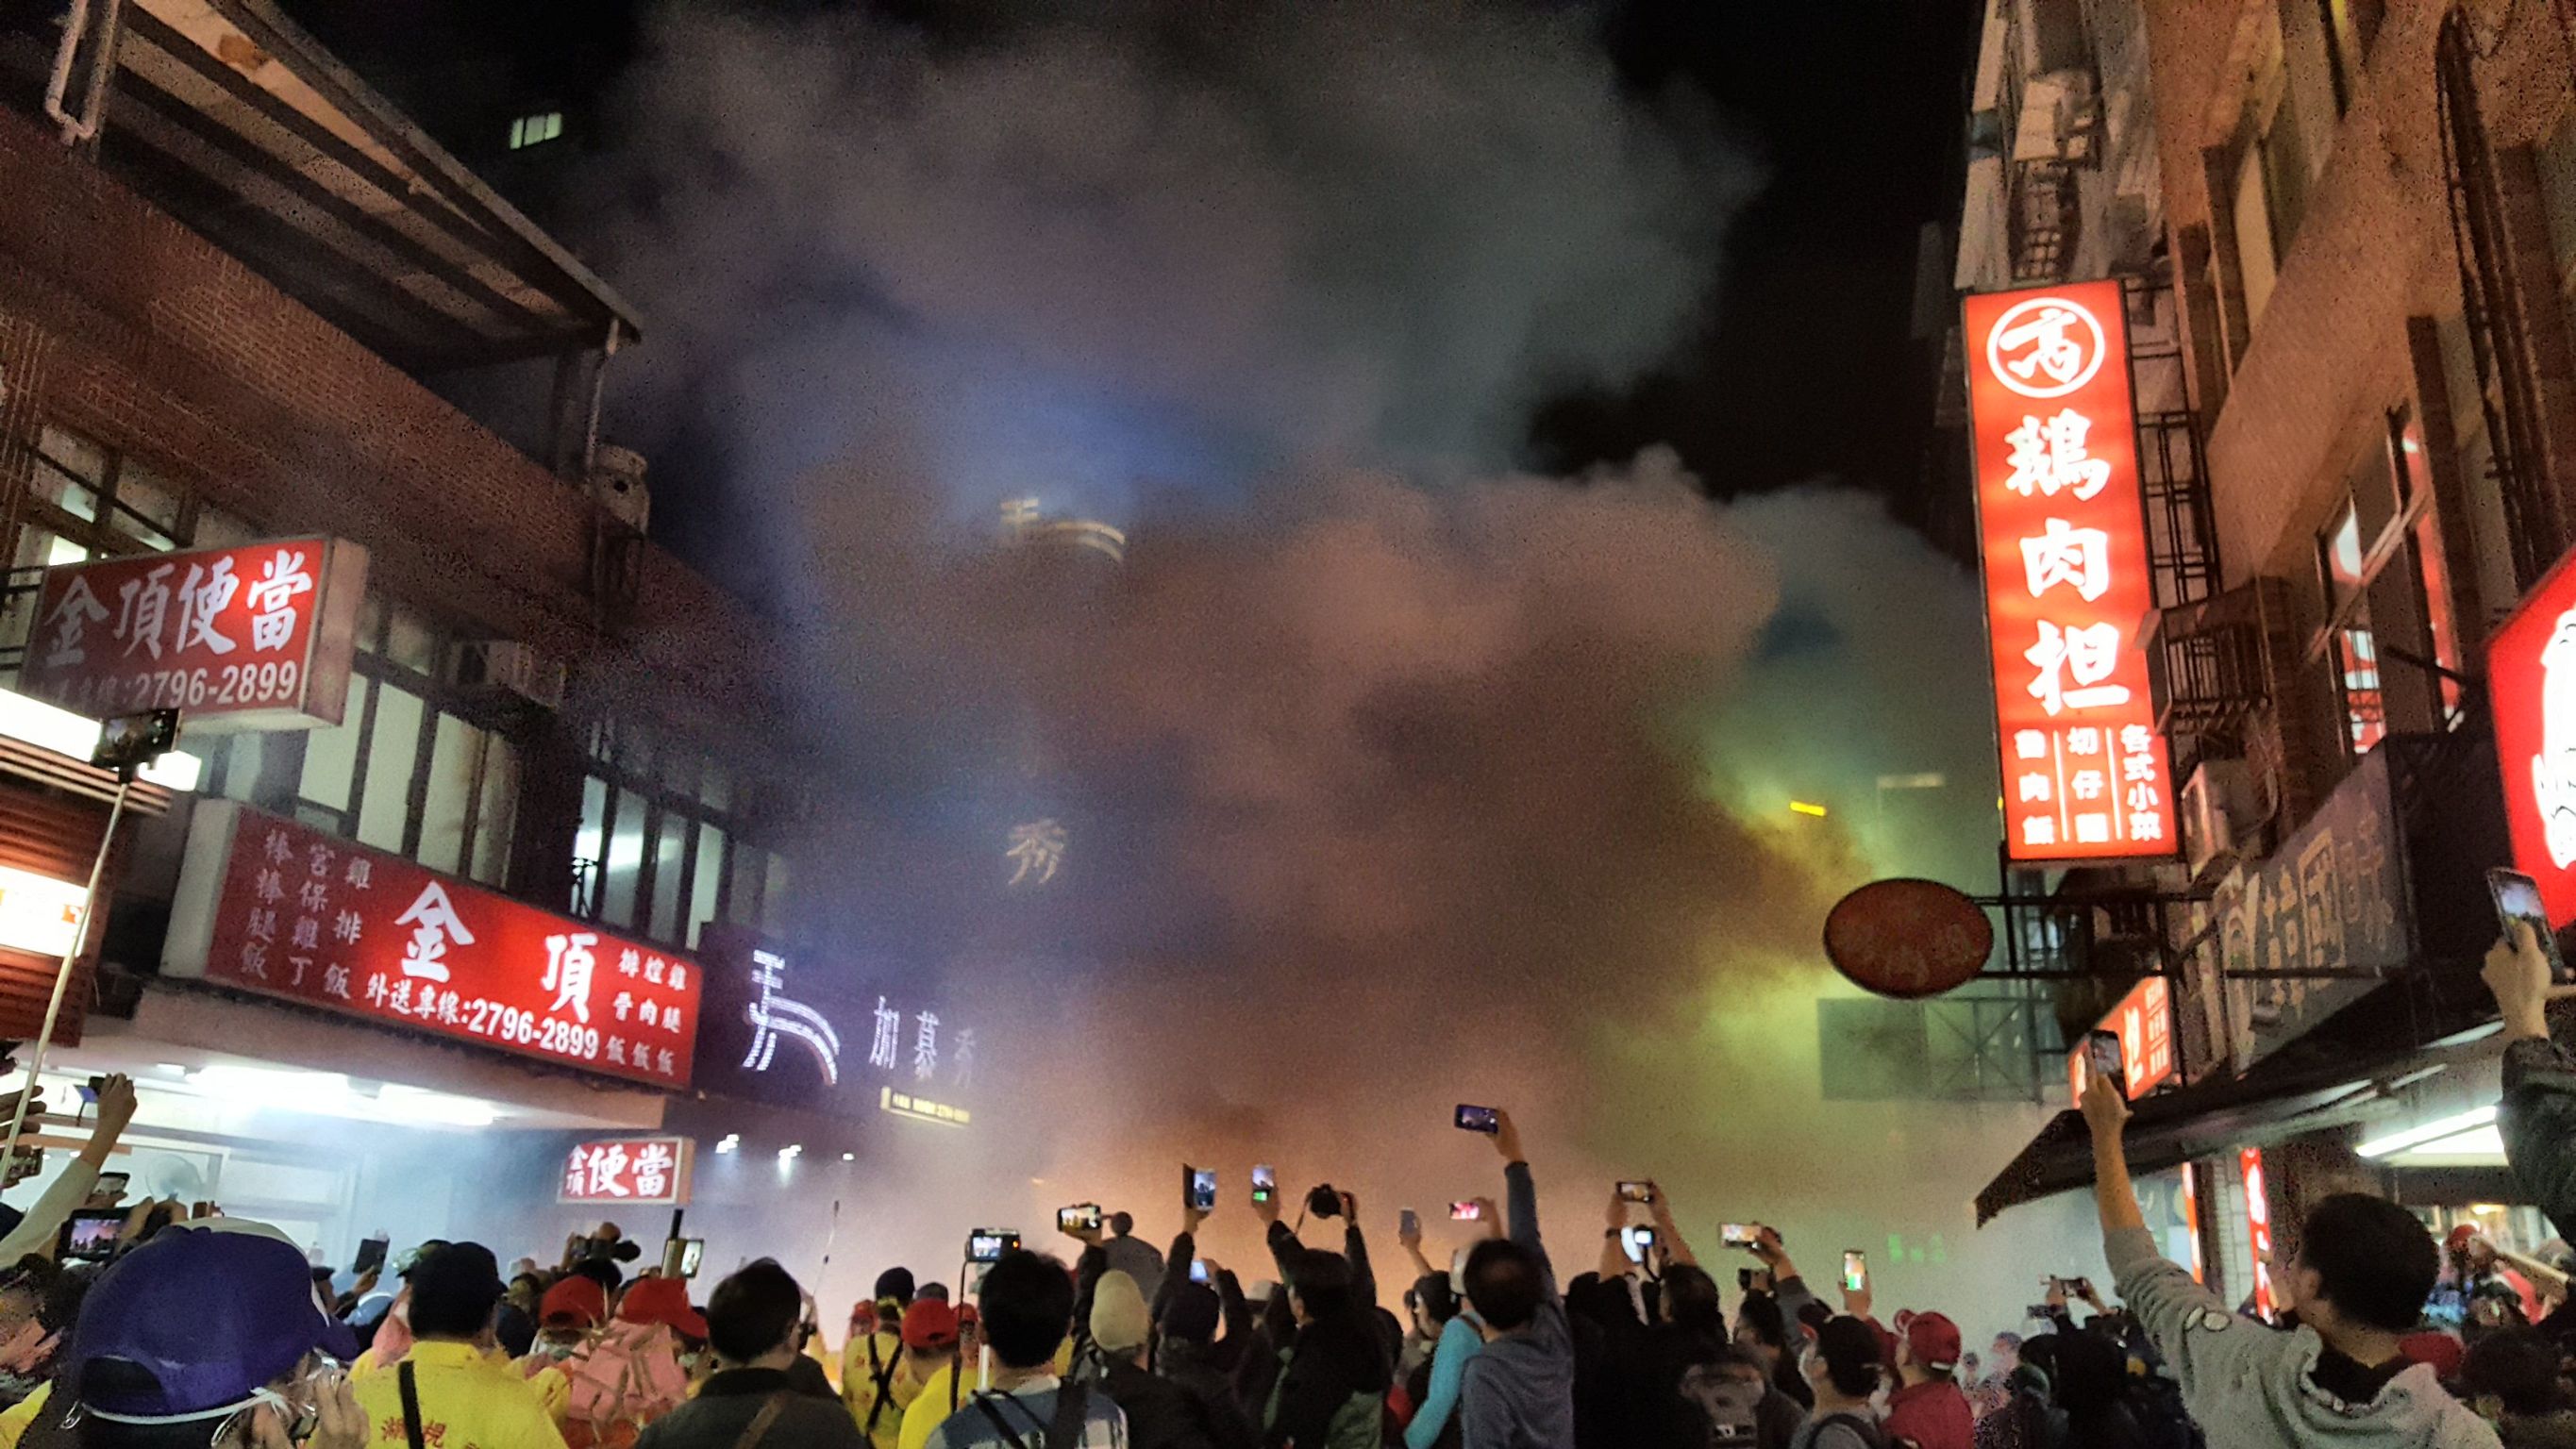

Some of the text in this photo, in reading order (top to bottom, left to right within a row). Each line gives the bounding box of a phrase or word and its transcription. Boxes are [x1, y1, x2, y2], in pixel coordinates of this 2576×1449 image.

[44, 549, 312, 667] 金頂便當
[2120, 724, 2163, 841] 各式小菜
[394, 879, 597, 1024] 金頂
[365, 972, 600, 1061] 外送專線:2796-2899
[587, 1142, 674, 1198] 便當
